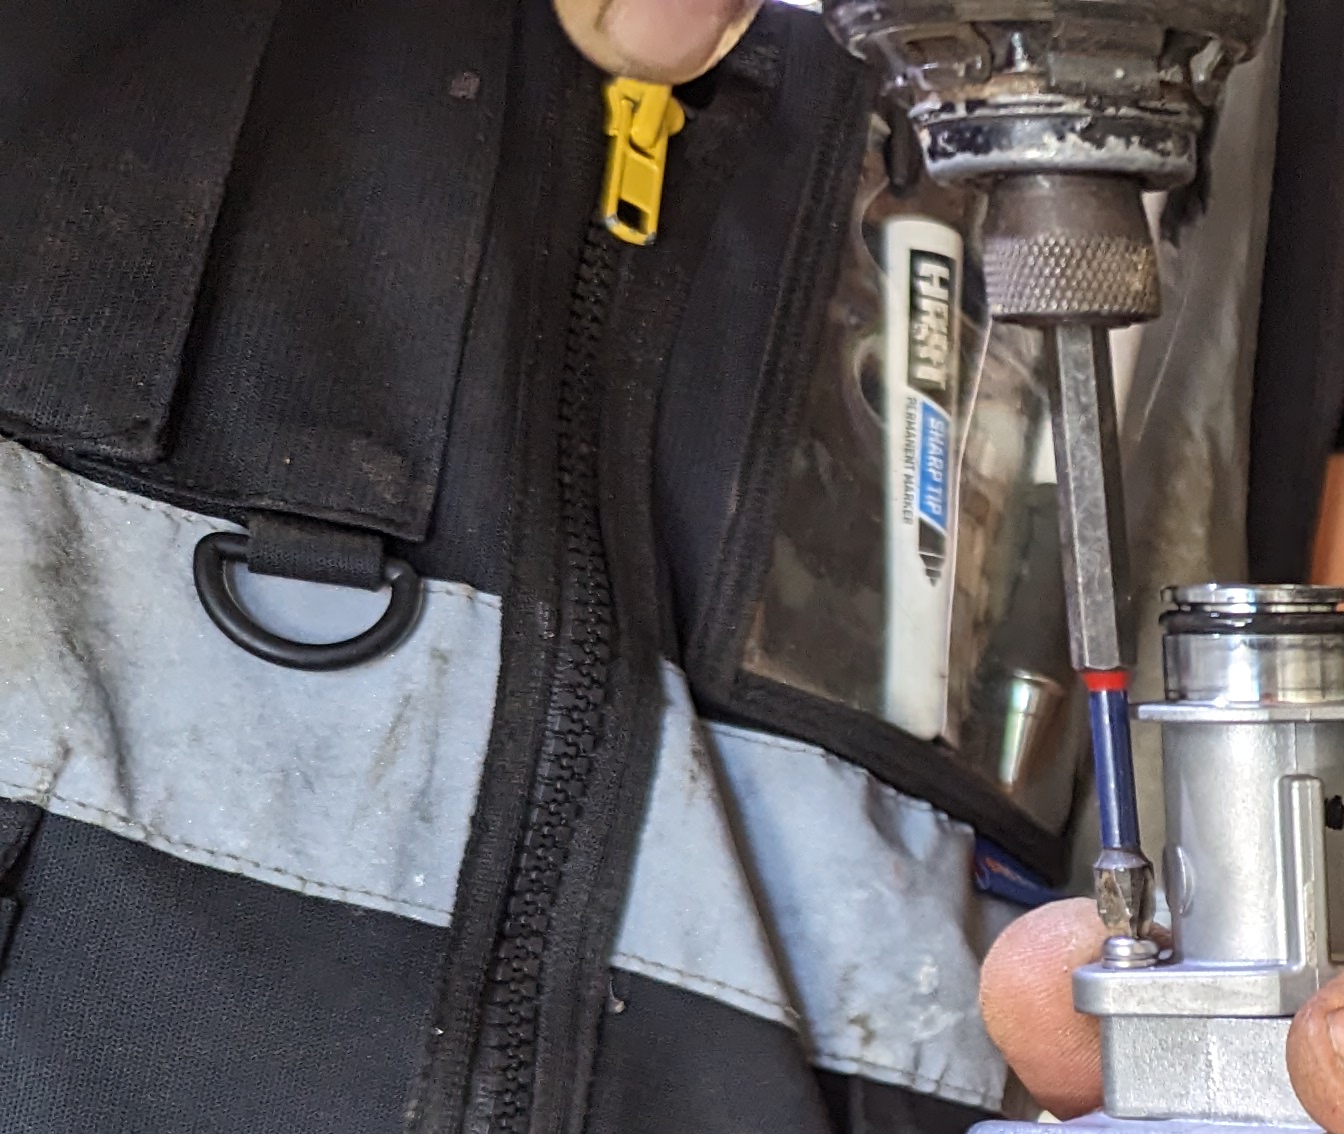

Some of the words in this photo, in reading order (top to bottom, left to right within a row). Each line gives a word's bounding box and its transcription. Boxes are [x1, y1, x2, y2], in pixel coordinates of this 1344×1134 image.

[904, 397, 917, 471] PERMANENT
[927, 417, 945, 482] SHARP
[902, 473, 915, 525] MARKER
[924, 486, 943, 515] TIP
